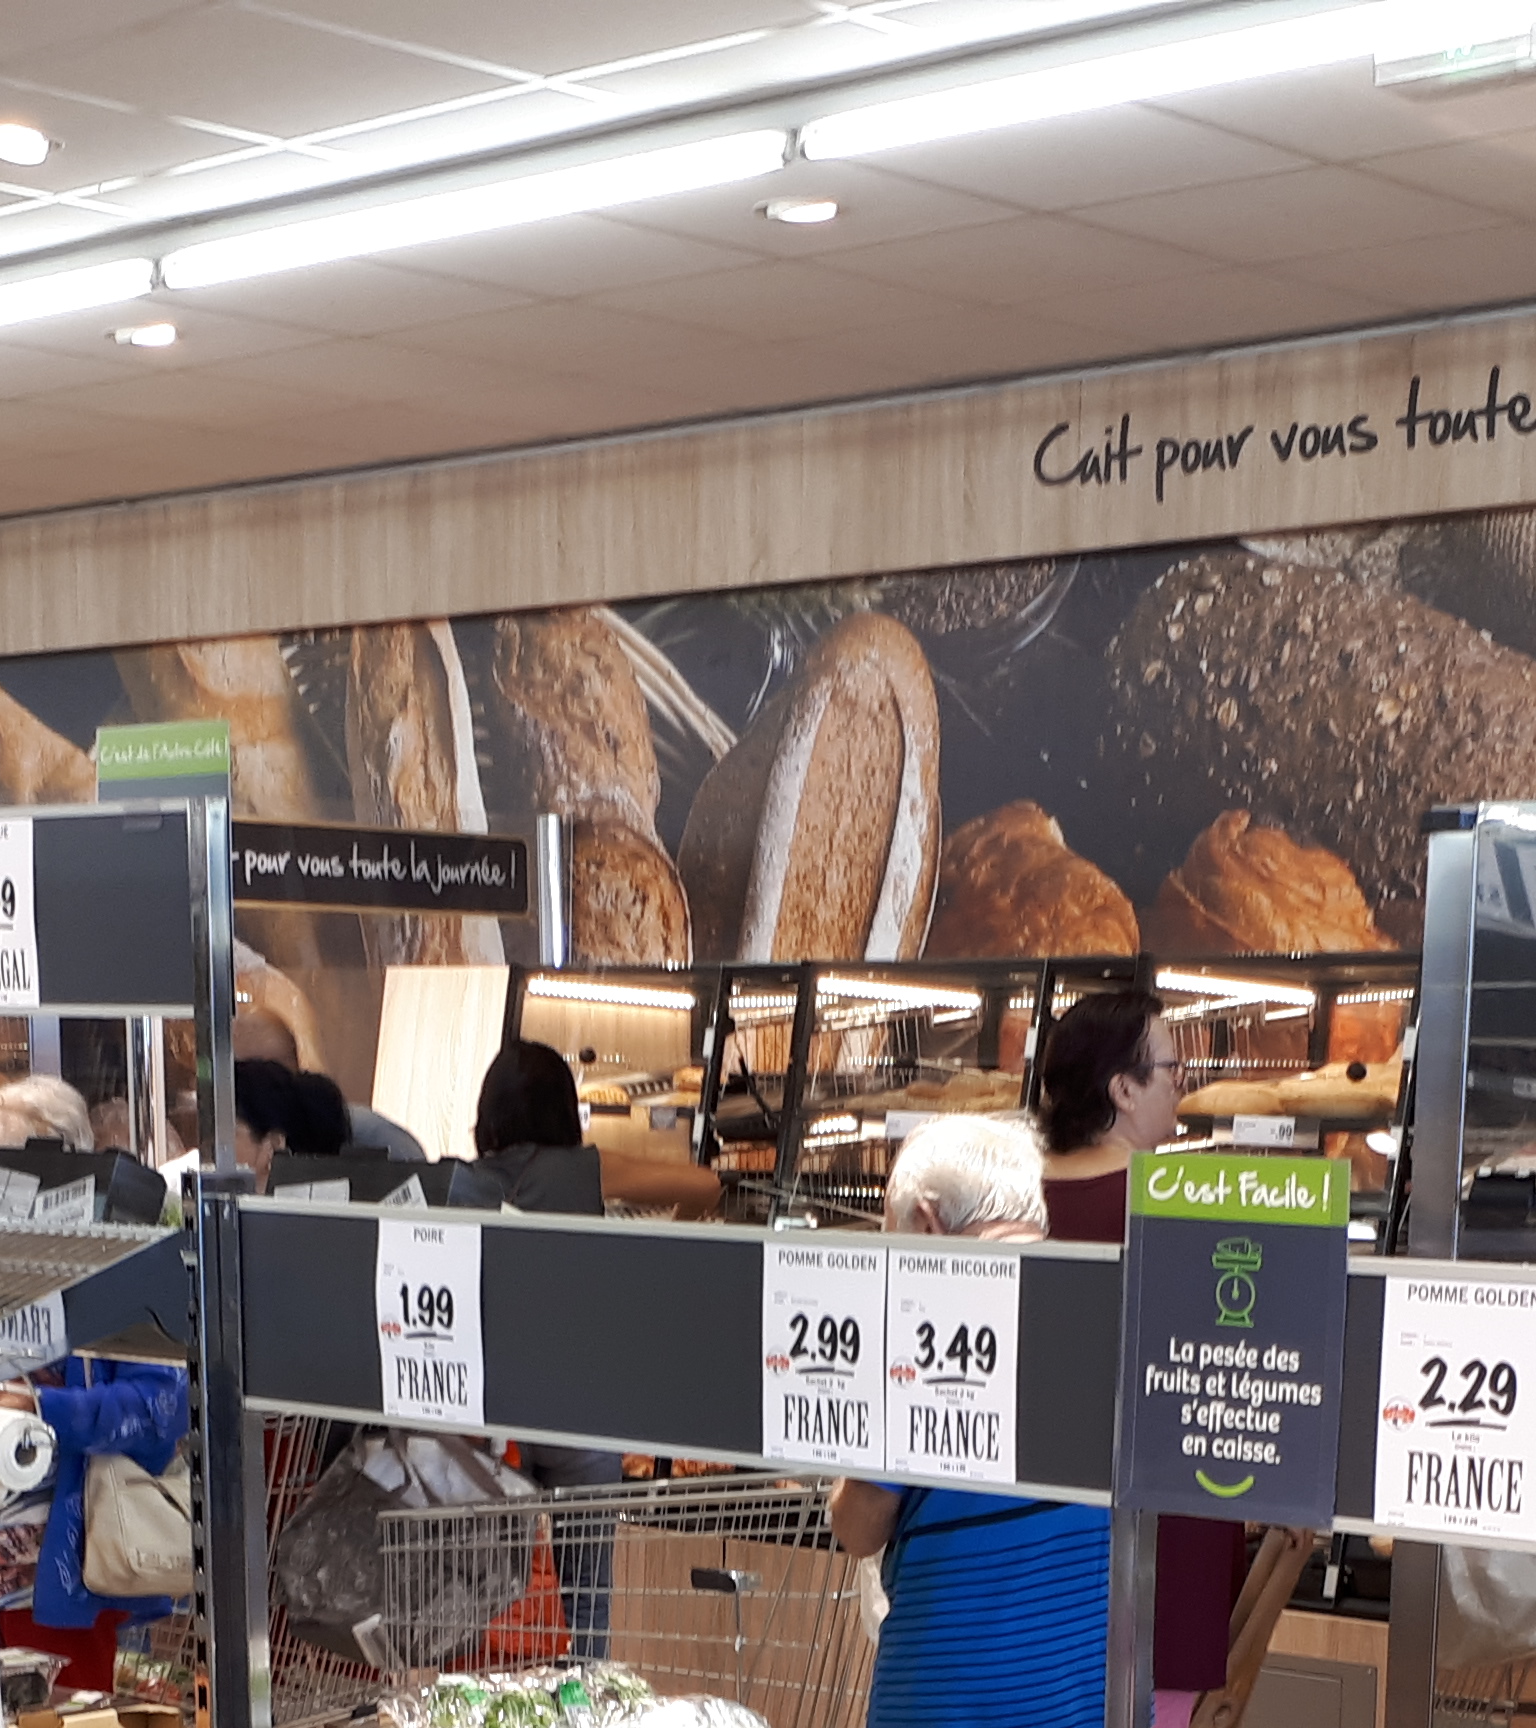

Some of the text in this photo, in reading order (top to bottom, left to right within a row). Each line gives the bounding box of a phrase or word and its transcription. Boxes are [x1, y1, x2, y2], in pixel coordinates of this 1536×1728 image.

[1034, 414, 1143, 487] Cuit
[1155, 423, 1253, 503] pour
[1270, 411, 1378, 463] vous
[244, 849, 290, 886] pour
[297, 853, 344, 878] vous
[349, 841, 407, 881] toute
[410, 839, 431, 885] la
[430, 853, 506, 896] journée
[1148, 1166, 1231, 1206] C'est
[1238, 1169, 1315, 1210] Facile
[413, 1227, 445, 1244] POIRE
[778, 1249, 877, 1272] POMME GOLDEN
[899, 1256, 1016, 1279] POMME BICOLORE
[400, 1282, 454, 1329] 1.99
[1406, 1284, 1468, 1303] POMME
[789, 1312, 860, 1365] 2.99
[914, 1320, 997, 1375] 3.49
[1169, 1337, 1300, 1373] La pesée des
[395, 1355, 468, 1407] FRANCE
[1146, 1364, 1322, 1408] fruits et légumes
[1418, 1355, 1518, 1418] 2.29
[783, 1393, 869, 1449] FRANCE
[909, 1404, 1000, 1462] FRANCE
[1180, 1402, 1281, 1435] s'effectue
[1182, 1435, 1282, 1466] en caisse.
[1405, 1450, 1524, 1515] FRANCE
